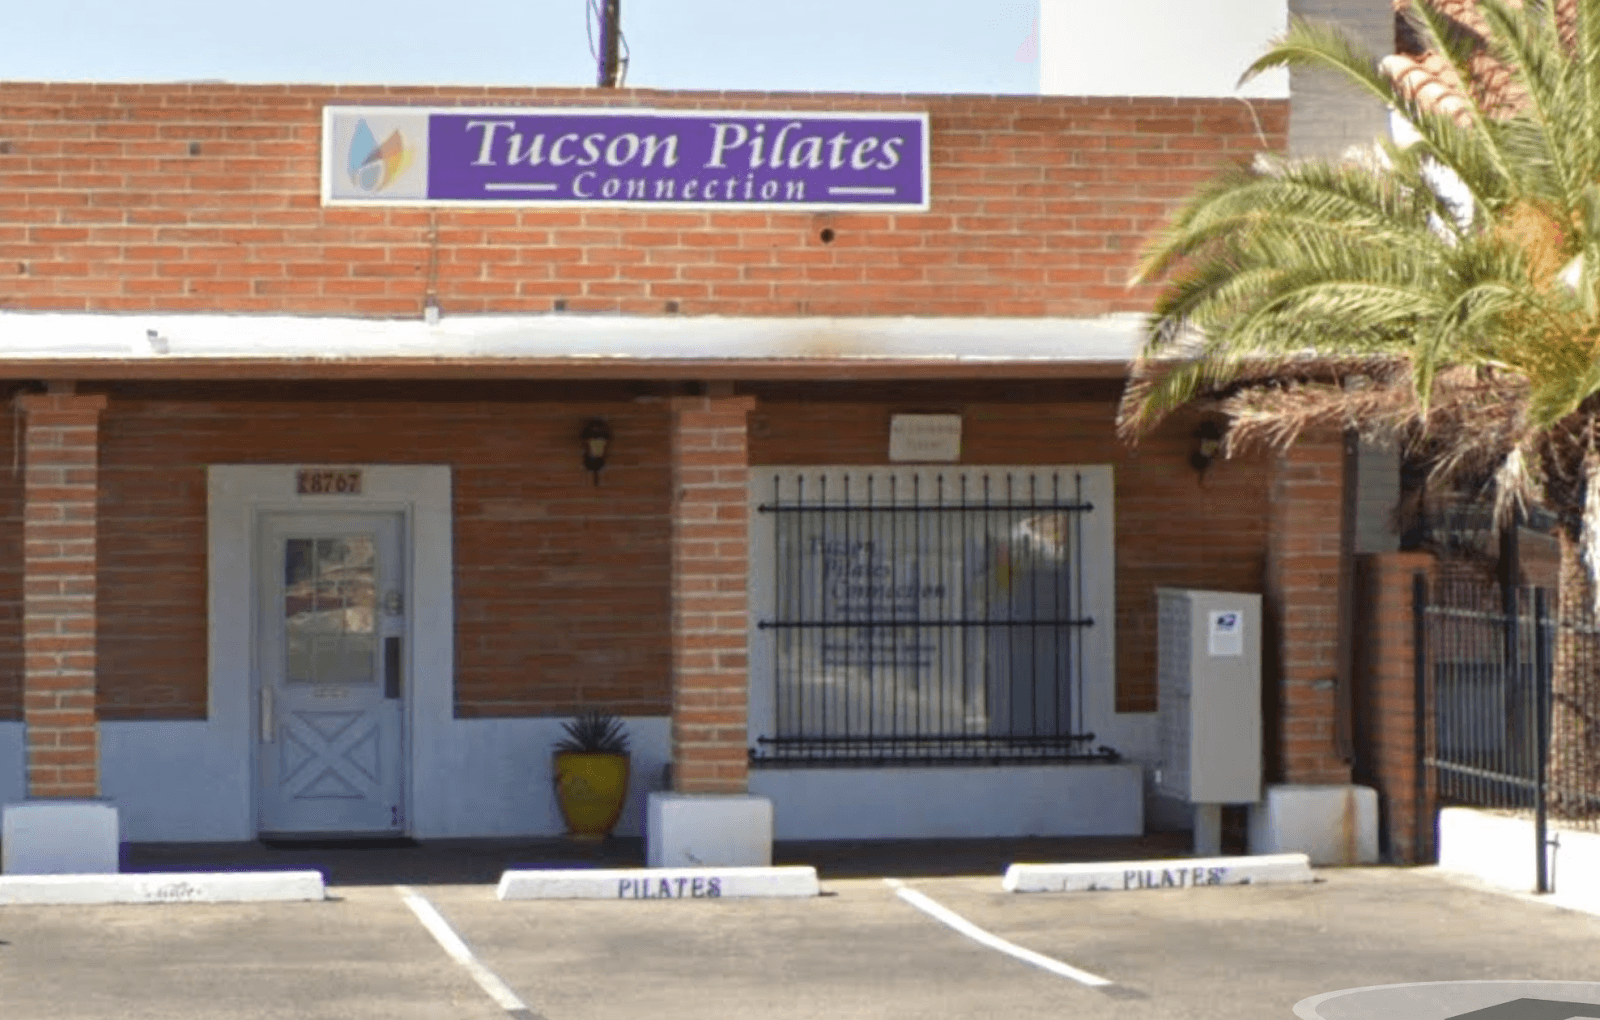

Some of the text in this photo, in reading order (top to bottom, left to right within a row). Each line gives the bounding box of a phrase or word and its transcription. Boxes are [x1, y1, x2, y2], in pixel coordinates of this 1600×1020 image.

[465, 118, 905, 171] Tucson Pilates
[571, 170, 808, 201] Connection
[618, 877, 721, 899] PILATES
[1123, 867, 1225, 890] PILATES
